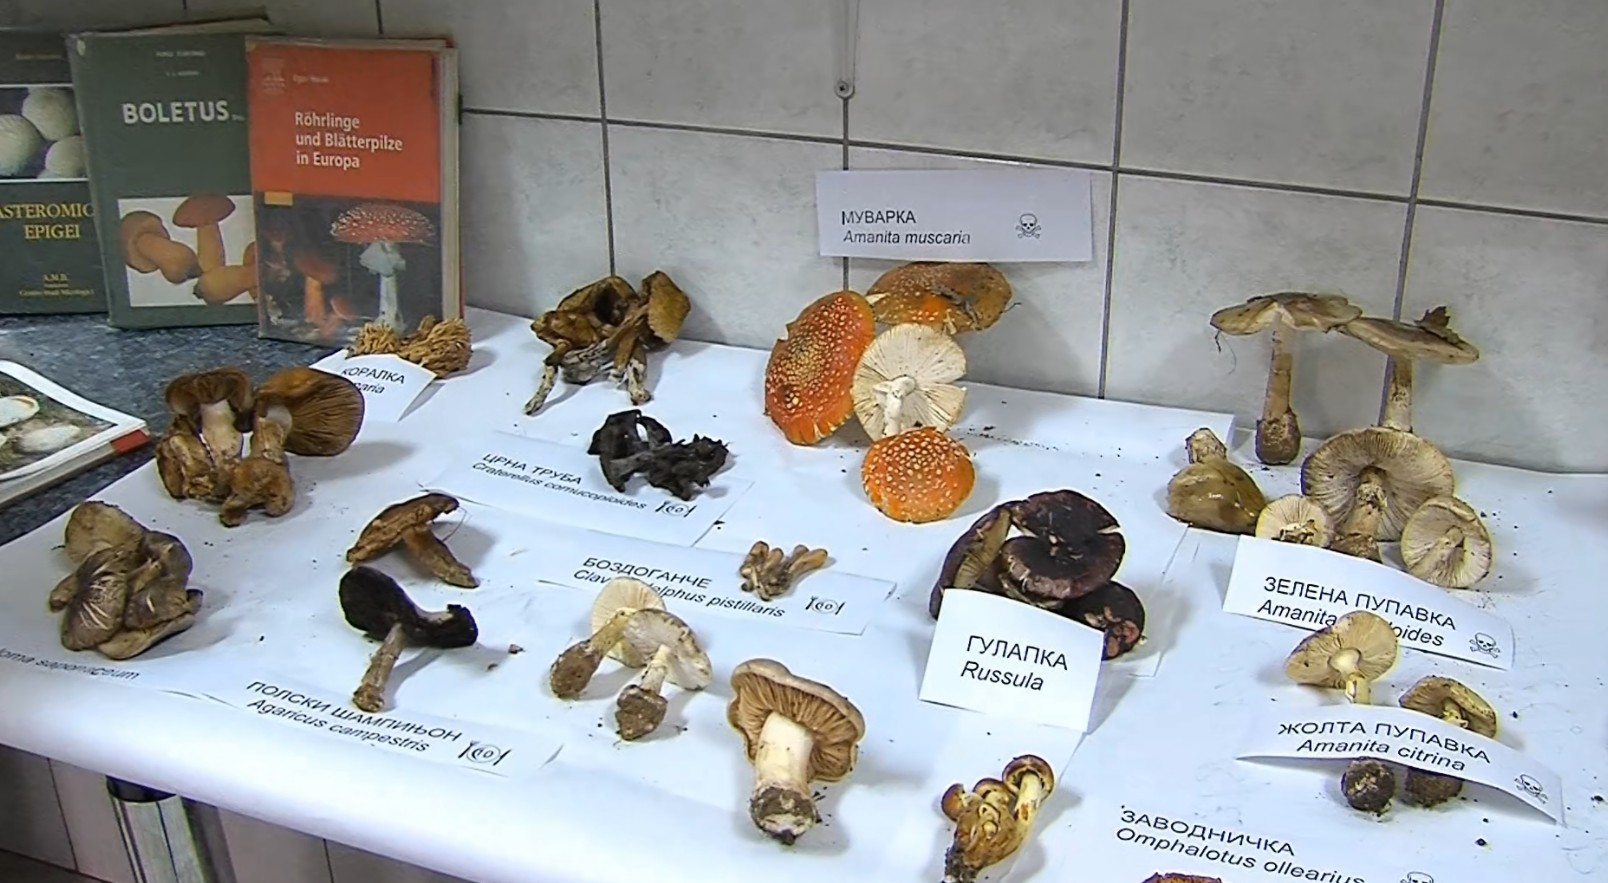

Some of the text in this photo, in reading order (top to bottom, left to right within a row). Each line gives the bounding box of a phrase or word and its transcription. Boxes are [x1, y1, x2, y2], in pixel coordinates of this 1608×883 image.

[122, 100, 230, 124] BOLETUS
[294, 111, 360, 132] Röhrlinge
[295, 131, 403, 153] und Blätterpilze
[296, 150, 360, 170] in Europa
[24, 224, 81, 239] EPIGEI
[841, 210, 917, 226] МУВАРКА
[843, 229, 972, 245] Amanita muscaria
[472, 461, 544, 486] Craterellus
[482, 453, 583, 486] ЦРНА ТРУБА
[582, 556, 713, 590] БОЗДОГАНЧЕ
[707, 595, 786, 618] pistillaris
[1256, 598, 1338, 627] Amanita
[1263, 575, 1457, 631] ЗЕЛЕНА ПУПАВКА
[966, 634, 1068, 671] ГУЛАПКА
[960, 660, 1044, 691] Russula
[246, 681, 463, 743] ПОЛСКИ ШАМПИЊОН
[246, 698, 431, 752] Agaricus campestris
[1278, 721, 1491, 764] ЖОЛТА ПУПАВКА
[1296, 738, 1466, 772] Amanita citrina
[1121, 809, 1296, 857] ЗАВОДНИЧКА
[1116, 827, 1367, 883] Omphalotus ollearius
